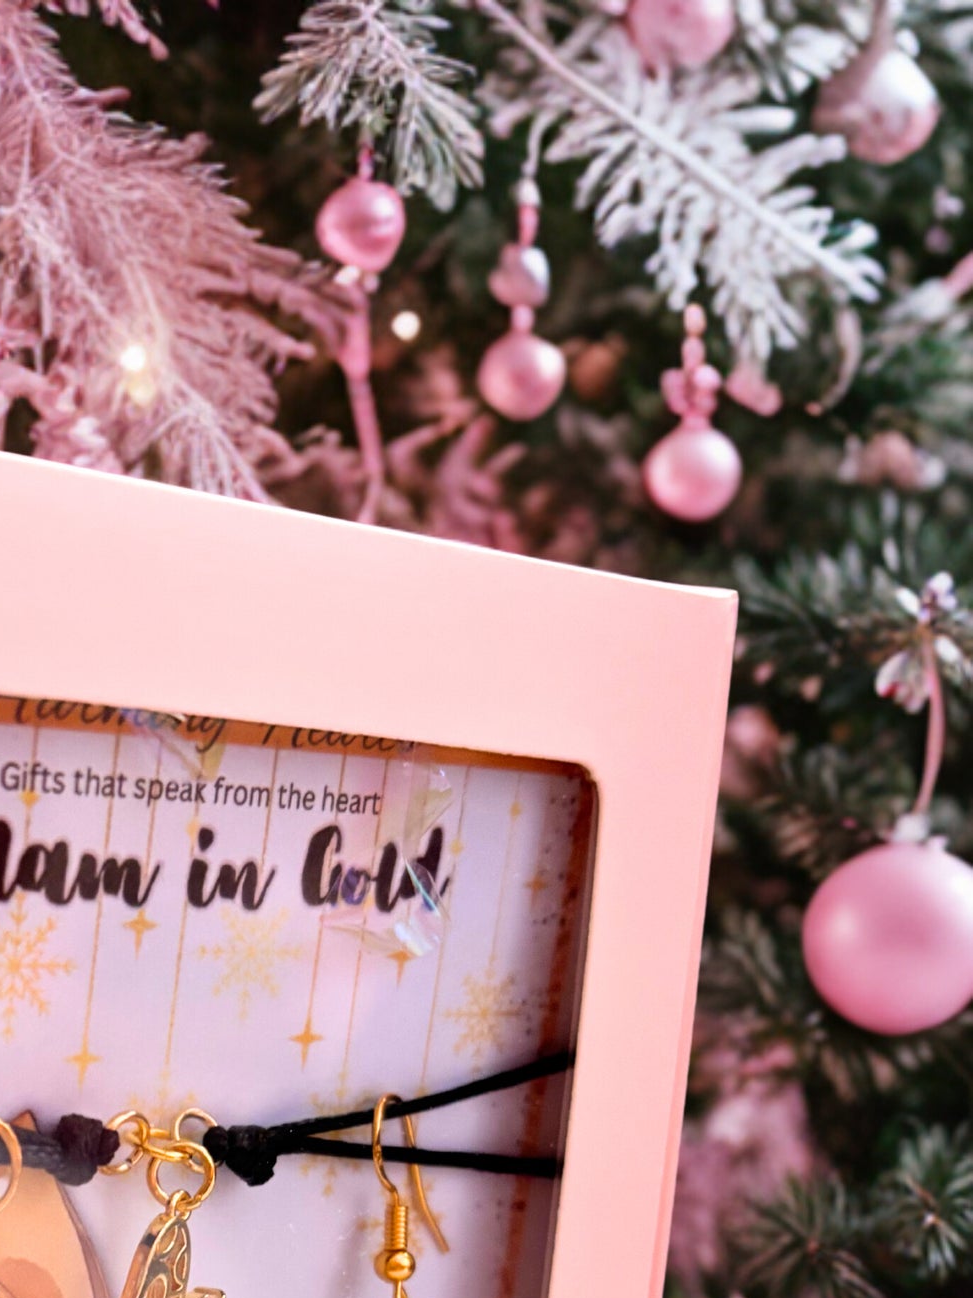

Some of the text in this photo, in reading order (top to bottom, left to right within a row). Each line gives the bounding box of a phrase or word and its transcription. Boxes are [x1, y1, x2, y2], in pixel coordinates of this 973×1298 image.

[0, 761, 381, 815] Gifts that speak from the heart
[187, 827, 276, 911] in
[301, 826, 450, 914] Gold
